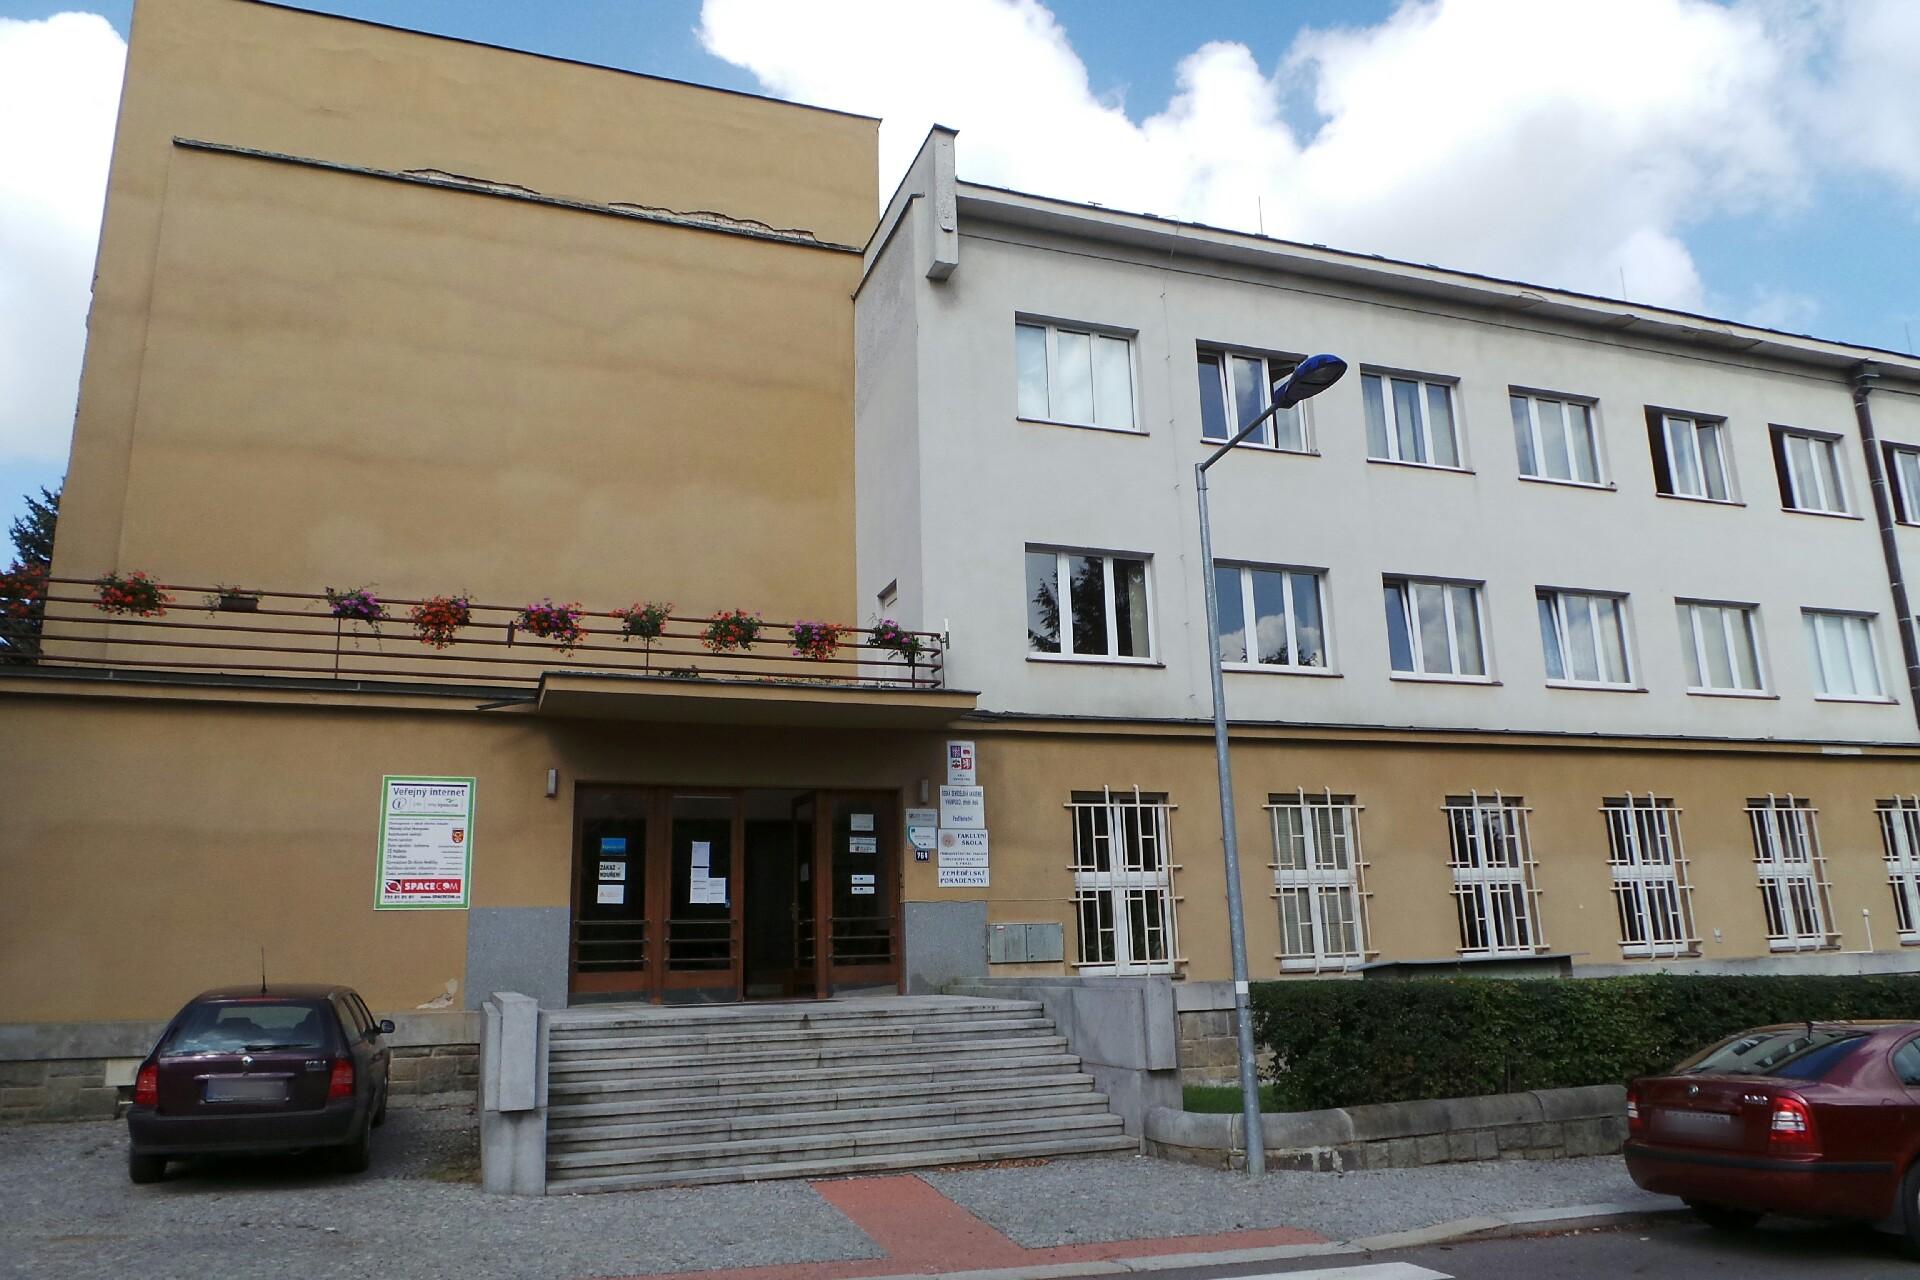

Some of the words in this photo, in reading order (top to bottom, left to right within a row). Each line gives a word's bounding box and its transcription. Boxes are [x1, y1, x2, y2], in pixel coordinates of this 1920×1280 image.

[393, 787, 427, 798] Veřejný
[430, 787, 465, 797] internet
[404, 882, 459, 891] SPACECOM
